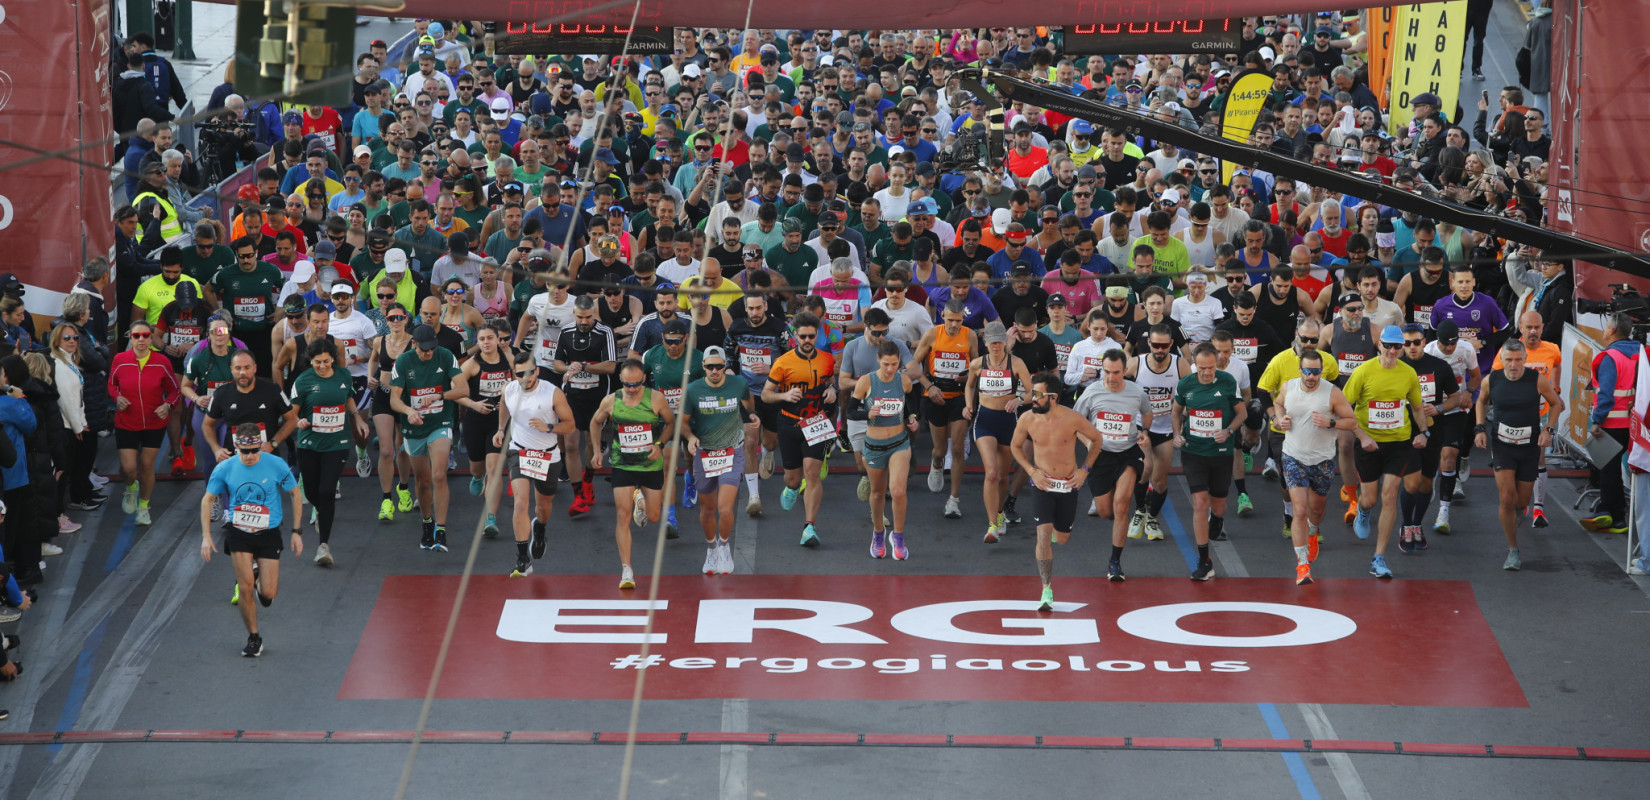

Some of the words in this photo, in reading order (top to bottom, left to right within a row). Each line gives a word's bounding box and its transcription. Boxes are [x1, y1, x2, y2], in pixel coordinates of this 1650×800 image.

[1191, 42, 1234, 50] GARMIN
[1232, 90, 1267, 102] 1:44:59
[174, 335, 195, 343] 12564
[941, 361, 960, 369] 4342
[487, 372, 505, 380] ERGO
[986, 379, 1005, 387] 5088
[417, 387, 436, 396] ERGO
[664, 388, 682, 396] ERGO
[1143, 386, 1173, 395] REZN
[881, 403, 901, 411] 4997
[1104, 413, 1124, 421] ERGO
[1196, 410, 1214, 418] ERGO
[1375, 410, 1395, 419] 4868
[806, 413, 824, 425] ERGO
[1195, 419, 1215, 427] 4058
[624, 425, 644, 433] ERGO
[810, 421, 828, 433] 4324
[1103, 422, 1123, 431] 5342
[1504, 427, 1525, 436] 4277
[624, 433, 648, 443] 15473
[526, 450, 545, 458] ERGO
[240, 504, 263, 513] ERGO
[240, 513, 262, 524] 2777
[496, 599, 1357, 647] ERGO
[609, 654, 1252, 674] #ergogiaolous
